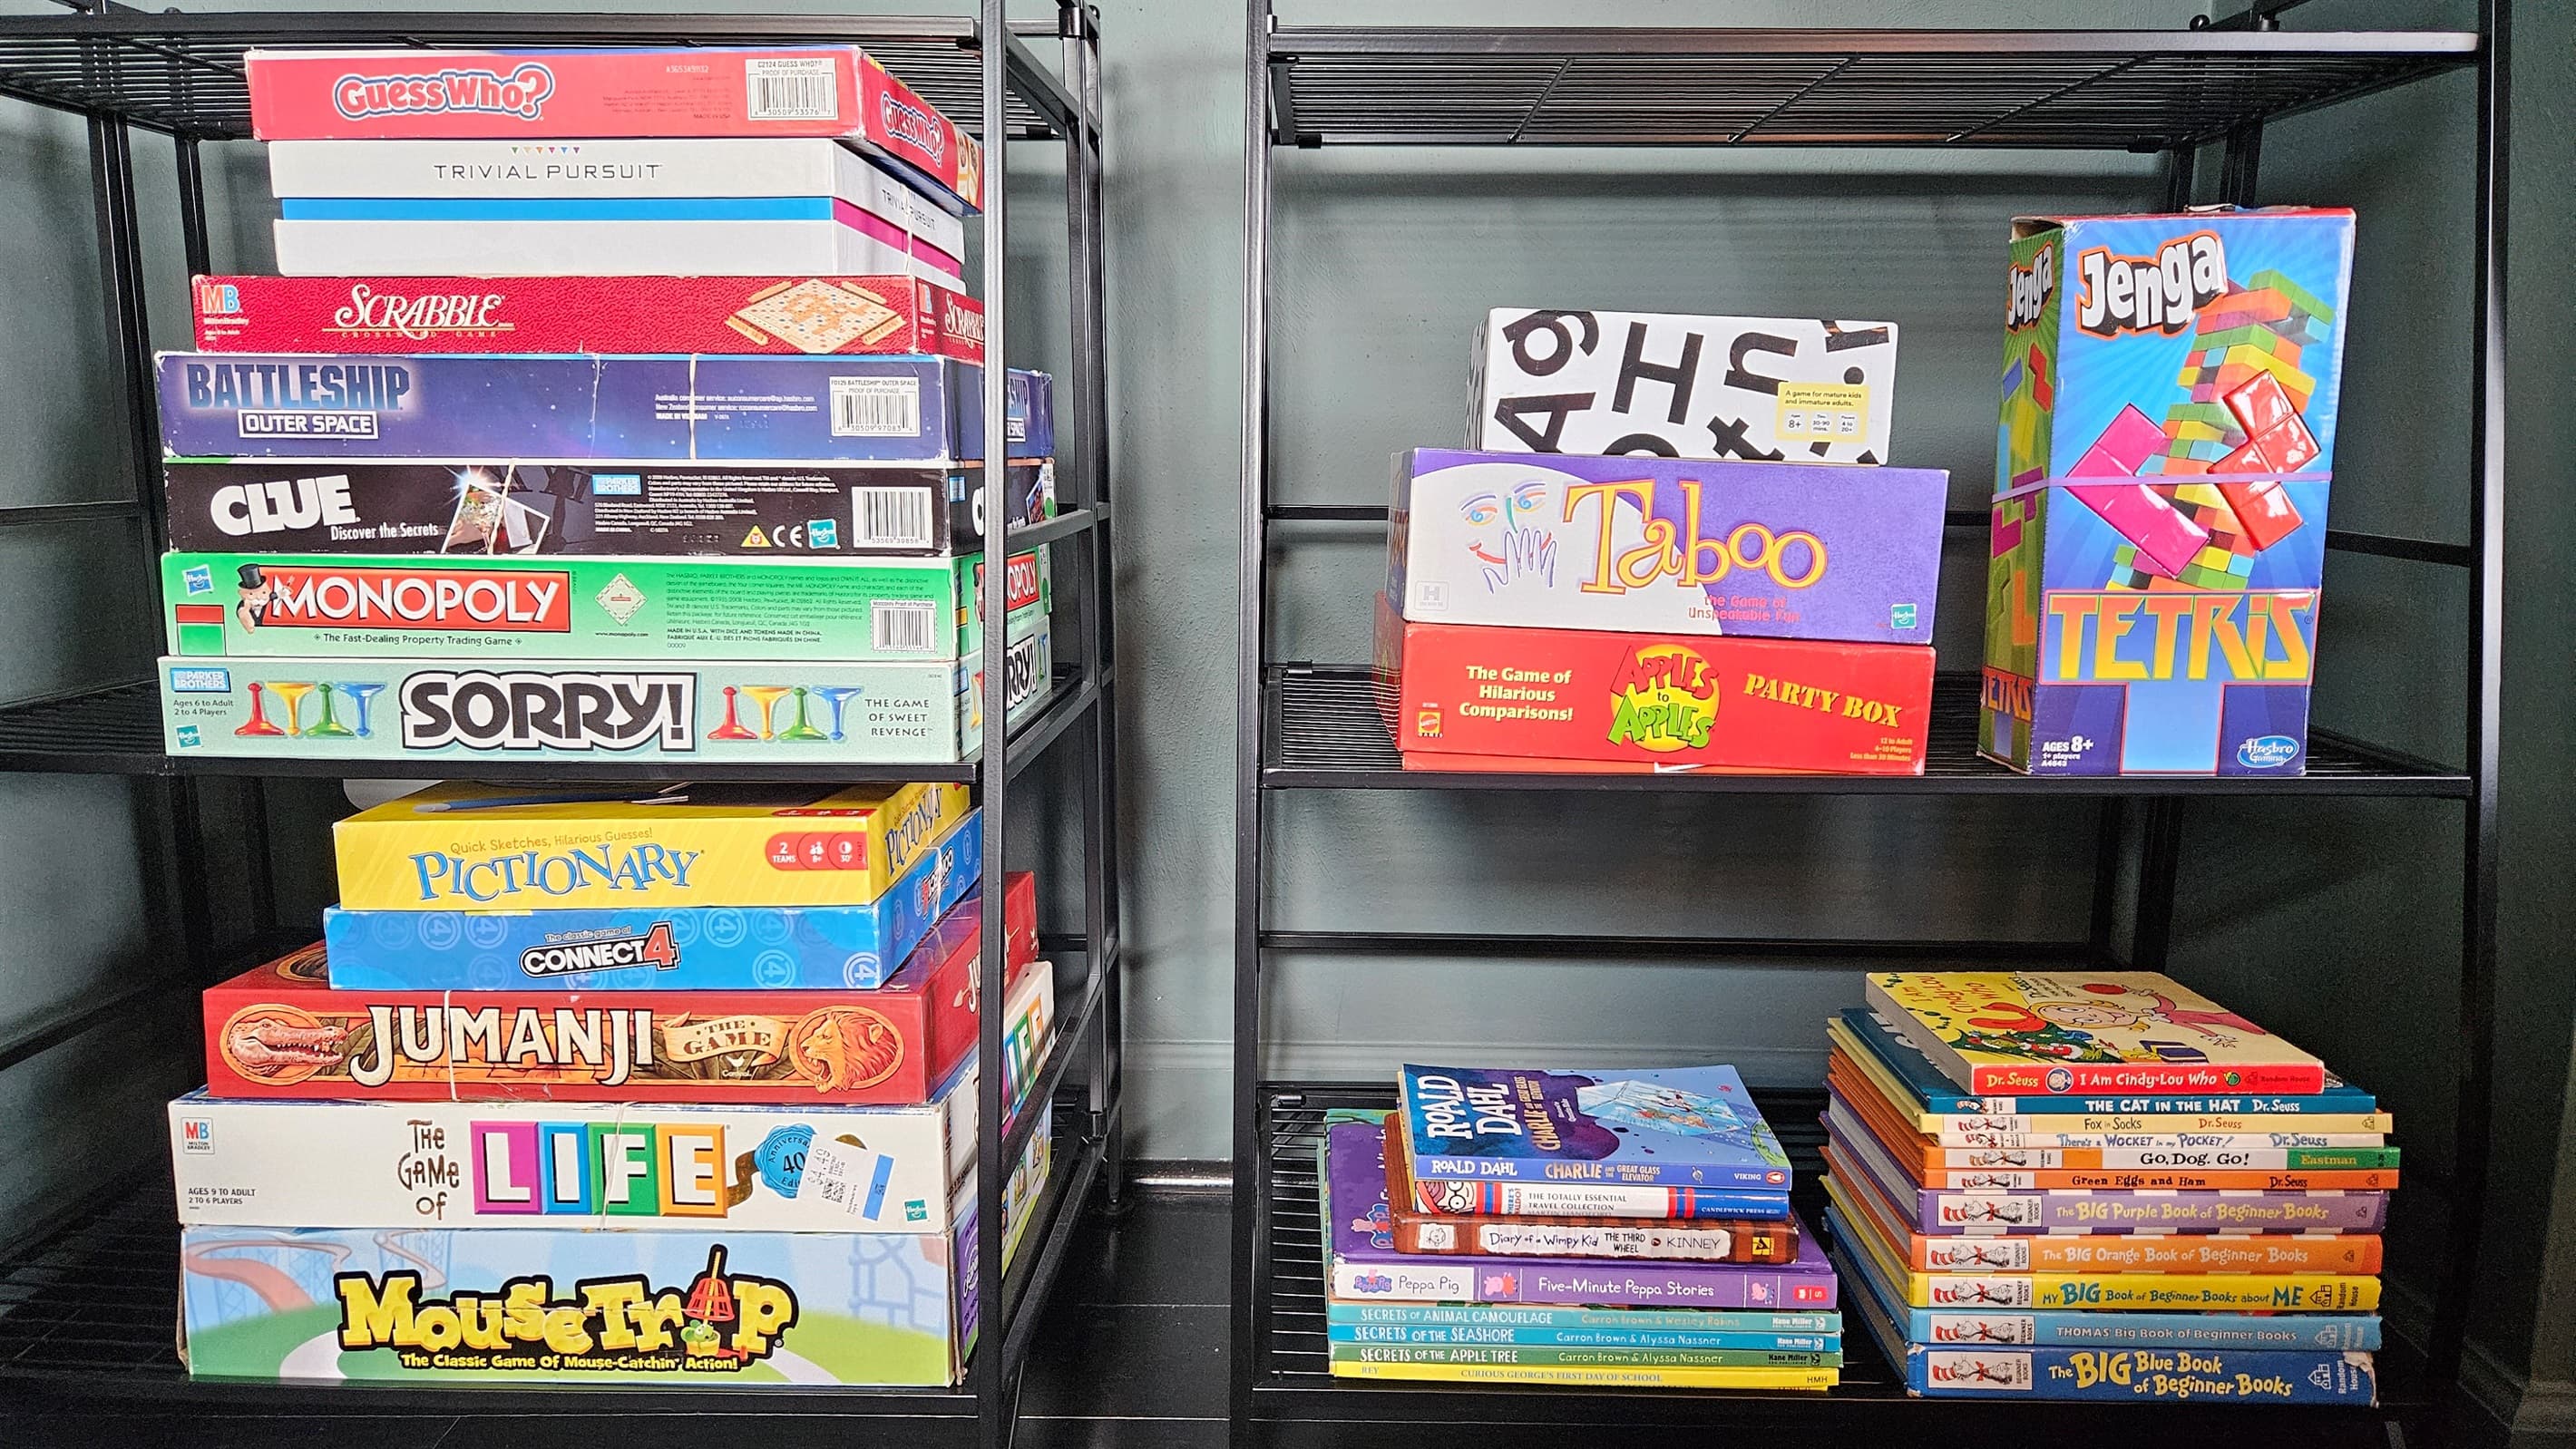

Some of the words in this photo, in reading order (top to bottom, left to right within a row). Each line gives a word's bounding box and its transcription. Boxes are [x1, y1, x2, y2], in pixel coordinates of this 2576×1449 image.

[434, 164, 538, 180] TRIVIAL
[546, 164, 660, 180] PURSUIT
[2007, 242, 2055, 330] Jenga
[2080, 233, 2226, 334] Jenga
[335, 284, 505, 340] SCRABBLE
[187, 363, 410, 411] BATTLESHIP
[1792, 392, 1811, 400] game
[245, 413, 308, 433] OUTER
[311, 414, 373, 434] SPACE
[210, 474, 356, 536] CLUE
[330, 526, 377, 541] Discover
[380, 525, 397, 539] the
[400, 523, 439, 538] Secrets
[1562, 478, 1830, 595] Taboo
[271, 575, 560, 625] MONOPOLY
[323, 633, 340, 643] The
[343, 634, 400, 646] Fast-Dealing
[402, 636, 444, 647] Property
[446, 637, 483, 648] Trading
[484, 637, 512, 647] Game
[186, 671, 225, 681] PARKER
[1466, 666, 1498, 681] The
[1501, 667, 1551, 683] Game
[1554, 669, 1572, 684] of
[1611, 646, 1720, 701] APPLES
[174, 679, 227, 690] BROTHERS
[864, 698, 890, 708] THE
[893, 699, 930, 708] GAME
[1478, 685, 1556, 703] Hilarious
[1657, 691, 1670, 704] to
[1742, 672, 1839, 714] PARTY
[1840, 695, 1903, 729] BOX
[173, 699, 192, 710] Ages
[194, 699, 200, 707] 6
[202, 700, 211, 708] to
[212, 699, 234, 708] Adult
[174, 708, 180, 716] 2
[181, 708, 190, 716] to
[200, 708, 228, 719] Players
[405, 676, 689, 744] SORRY!
[1459, 702, 1574, 723] Comparisons!
[868, 713, 886, 723] OF
[889, 714, 928, 723] SWEET
[1606, 694, 1716, 749] APPLES
[872, 727, 927, 737] REVENGE
[2042, 741, 2070, 753] AGES
[2071, 734, 2094, 754] 8+
[2240, 738, 2295, 756] Hasbro
[450, 841, 488, 855] Quick
[490, 834, 551, 851] Sketches,
[554, 831, 602, 848] Hilarious
[604, 827, 653, 842] Guesses!
[408, 843, 700, 901] PICTIONARY
[524, 939, 645, 974] CONNECT
[643, 926, 676, 968] 4
[703, 1019, 746, 1033] THE
[348, 1004, 654, 1087] JUMANJI
[683, 1031, 772, 1056] GAME
[1986, 1074, 2005, 1087] Dr.
[2005, 1072, 2039, 1088] Seuss
[2079, 1074, 2087, 1086] I
[2089, 1073, 2112, 1086] Am
[2188, 1072, 2218, 1086] Who
[2085, 1099, 2114, 1113] THE
[2120, 1098, 2151, 1113] CAT
[2154, 1101, 2171, 1113] IN
[2175, 1100, 2202, 1112] THE
[2208, 1099, 2241, 1113] HAT
[2252, 1098, 2269, 1113] Dr.
[2272, 1099, 2300, 1113] Seuss
[185, 1122, 210, 1139] MB
[2084, 1116, 2103, 1130] Fox
[2112, 1115, 2142, 1131] Socks
[2140, 1152, 2169, 1166] Go,
[2171, 1152, 2211, 1167] Dog.
[2217, 1152, 2249, 1166] Go!
[2299, 1153, 2357, 1165] Eastman
[477, 1127, 722, 1211] LIFE
[1430, 1160, 1477, 1174] ROALD
[1480, 1162, 1518, 1177] DAHL
[1545, 1162, 1603, 1180] CHARLIE
[1616, 1163, 1638, 1175] GREAT
[1639, 1165, 1661, 1176] GLASS
[1622, 1173, 1654, 1182] ELEVATOR
[1733, 1172, 1761, 1181] VIKING
[2072, 1176, 2109, 1185] Green
[2115, 1175, 2145, 1187] Eggs
[2151, 1175, 2173, 1185] and
[2178, 1177, 2206, 1186] Ham
[188, 1187, 210, 1195] AGES
[219, 1188, 229, 1196] TO
[231, 1189, 257, 1197] ADULT
[1528, 1192, 1545, 1201] THE
[1547, 1192, 1582, 1201] TOTALLY
[1584, 1194, 1628, 1202] ESSENTIAL
[1528, 1202, 1558, 1211] TRAVEL
[1560, 1203, 1615, 1211] COLLECTION
[2055, 1206, 2075, 1218] The
[2075, 1201, 2108, 1220] BIG
[2113, 1201, 2158, 1220] Purple
[2161, 1201, 2199, 1220] Book
[2200, 1207, 2212, 1219] of
[2216, 1202, 2282, 1222] Beginner
[2282, 1202, 2330, 1220] Books
[1488, 1231, 1522, 1247] Diary
[1524, 1235, 1534, 1244] of
[1543, 1233, 1579, 1250] Wimpy
[1581, 1234, 1599, 1248] Kid
[1666, 1236, 1722, 1250] KINNEY
[1399, 1275, 1436, 1295] Peppa
[1439, 1276, 1460, 1295] Pig
[1538, 1276, 1622, 1295] Five-Minute
[1625, 1279, 1663, 1299] Peppa
[1666, 1280, 1715, 1297] Stories
[1354, 1326, 1407, 1341] SECRETS
[1411, 1331, 1427, 1342] OF
[1429, 1331, 1447, 1342] THE
[1450, 1327, 1515, 1343] SEASHORE
[401, 1354, 431, 1367] The
[434, 1354, 489, 1368] Classic
[491, 1356, 537, 1368] Game
[541, 1356, 562, 1369] Of
[564, 1355, 680, 1371] Mouse-Catchin'
[686, 1356, 738, 1370] Action!
[2048, 1365, 2074, 1380] The
[2069, 1351, 2132, 1390] BIG
[2133, 1350, 2173, 1373] Blue
[2176, 1351, 2223, 1375] Book
[1807, 1375, 1829, 1385] HMH
[2132, 1379, 2150, 1395] of
[2152, 1373, 2235, 1399] Beginner
[2235, 1373, 2293, 1397] Books
